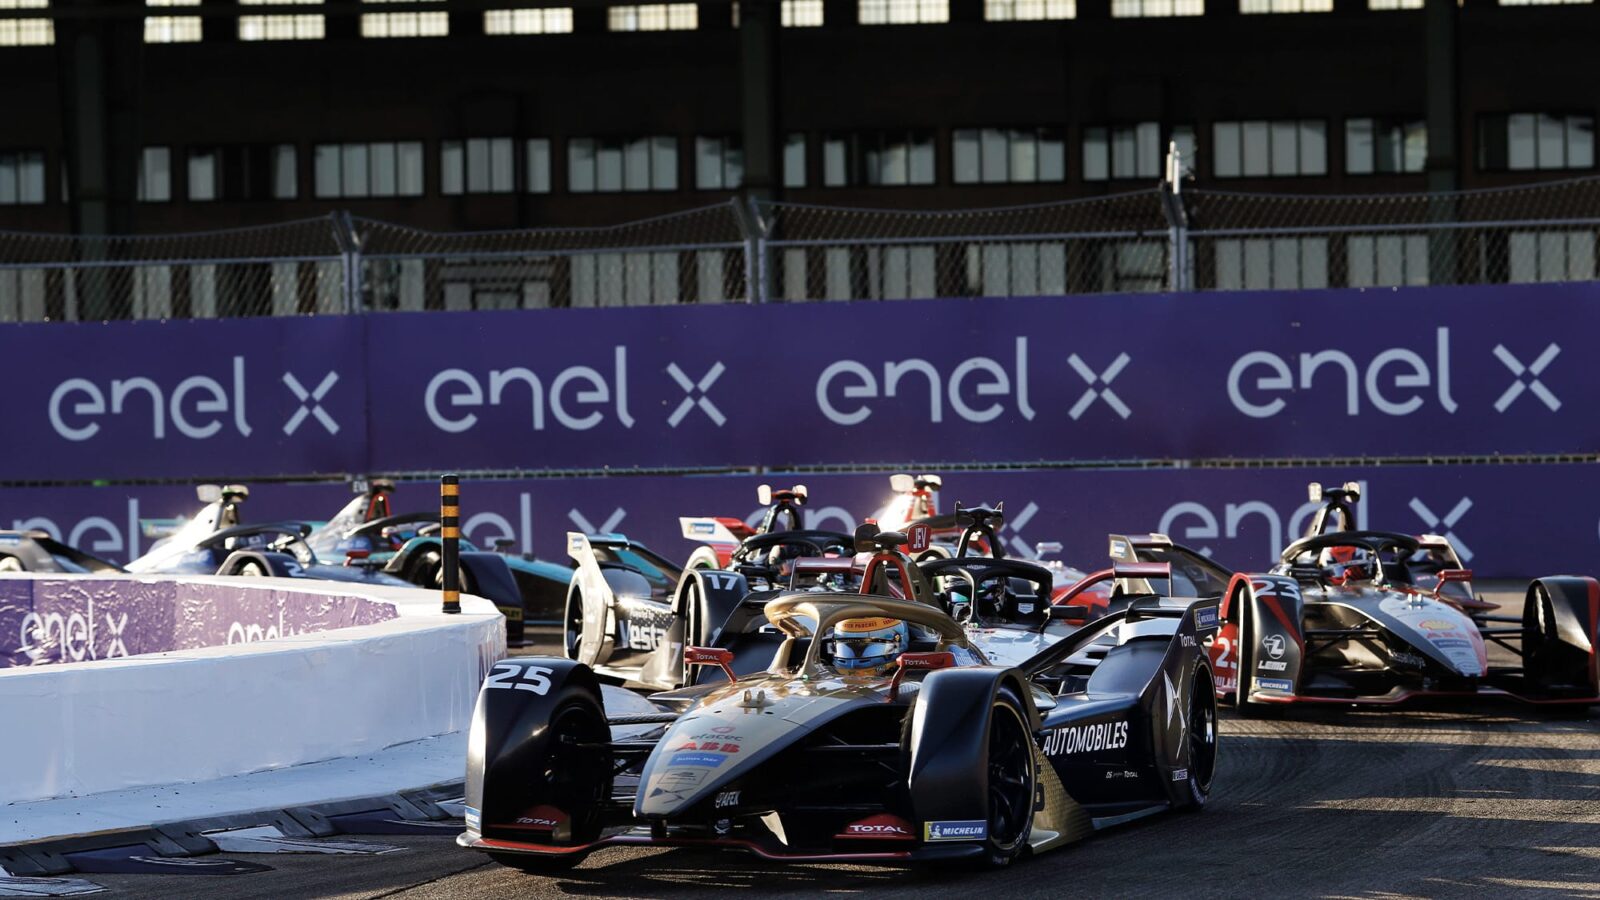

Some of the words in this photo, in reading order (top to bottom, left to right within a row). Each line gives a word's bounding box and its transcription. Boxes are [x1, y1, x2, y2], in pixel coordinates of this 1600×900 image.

[816, 336, 1036, 425] enel
[1227, 327, 1459, 418] enel
[49, 356, 252, 440] enel
[425, 346, 634, 432] enel
[12, 498, 138, 562] nel
[914, 527, 927, 550] JEV
[706, 574, 739, 591] 17
[1251, 580, 1301, 601] 23
[1179, 633, 1197, 648] TOTAL
[696, 653, 720, 661] TOTAL
[482, 664, 554, 697] 25
[674, 742, 741, 753] ABB
[1043, 720, 1129, 756] AUTOMOBILES
[850, 824, 908, 834] TOTAL
[942, 826, 984, 836] MICHELIN
